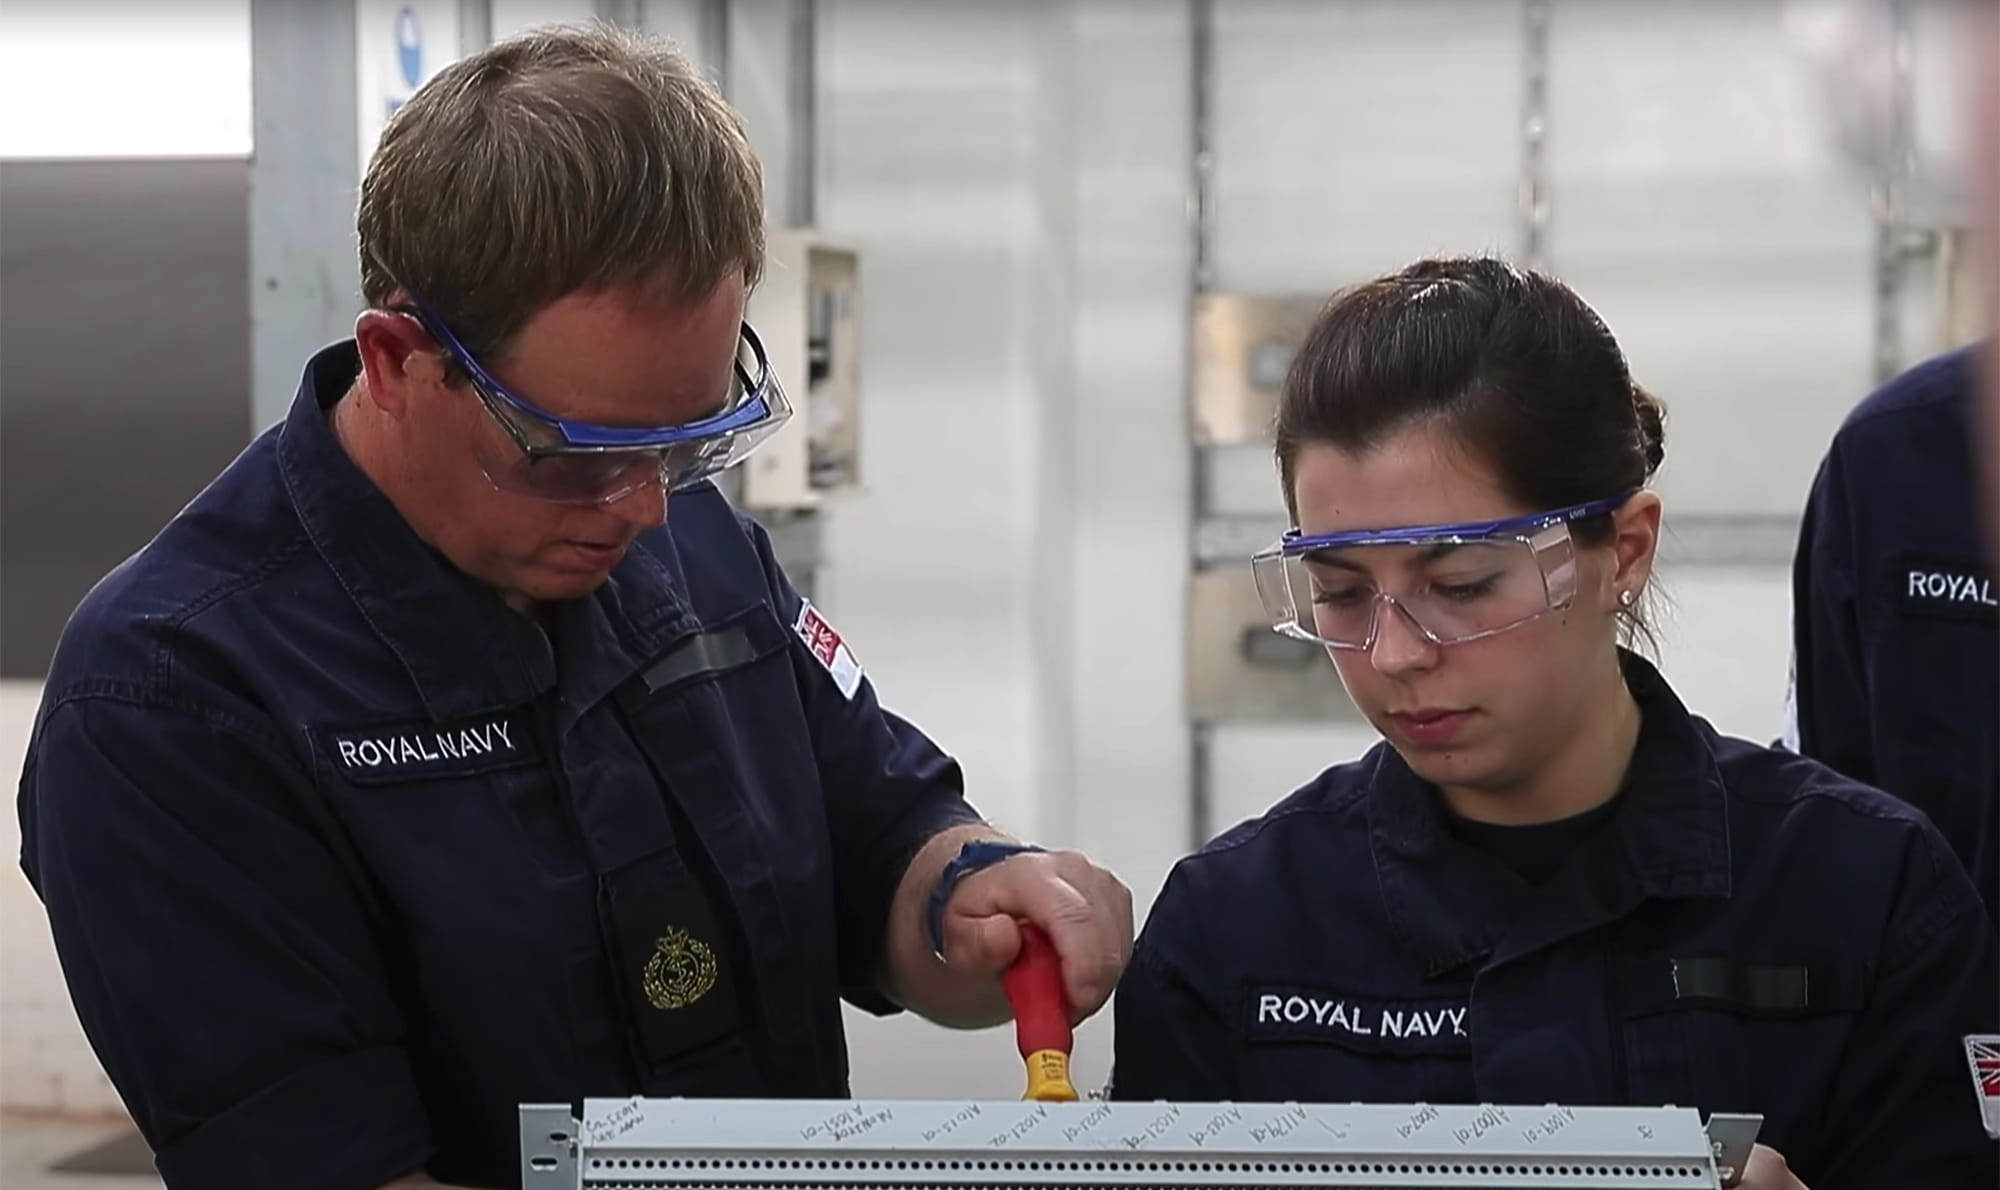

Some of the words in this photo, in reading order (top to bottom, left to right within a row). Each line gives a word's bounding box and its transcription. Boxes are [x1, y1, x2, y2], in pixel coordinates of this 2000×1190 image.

[1909, 571, 1998, 606] ROYAL
[337, 735, 439, 767] ROYAL
[436, 720, 514, 759] NAVY
[1259, 995, 1371, 1034] ROYAL
[1380, 1007, 1467, 1037] NAVY
